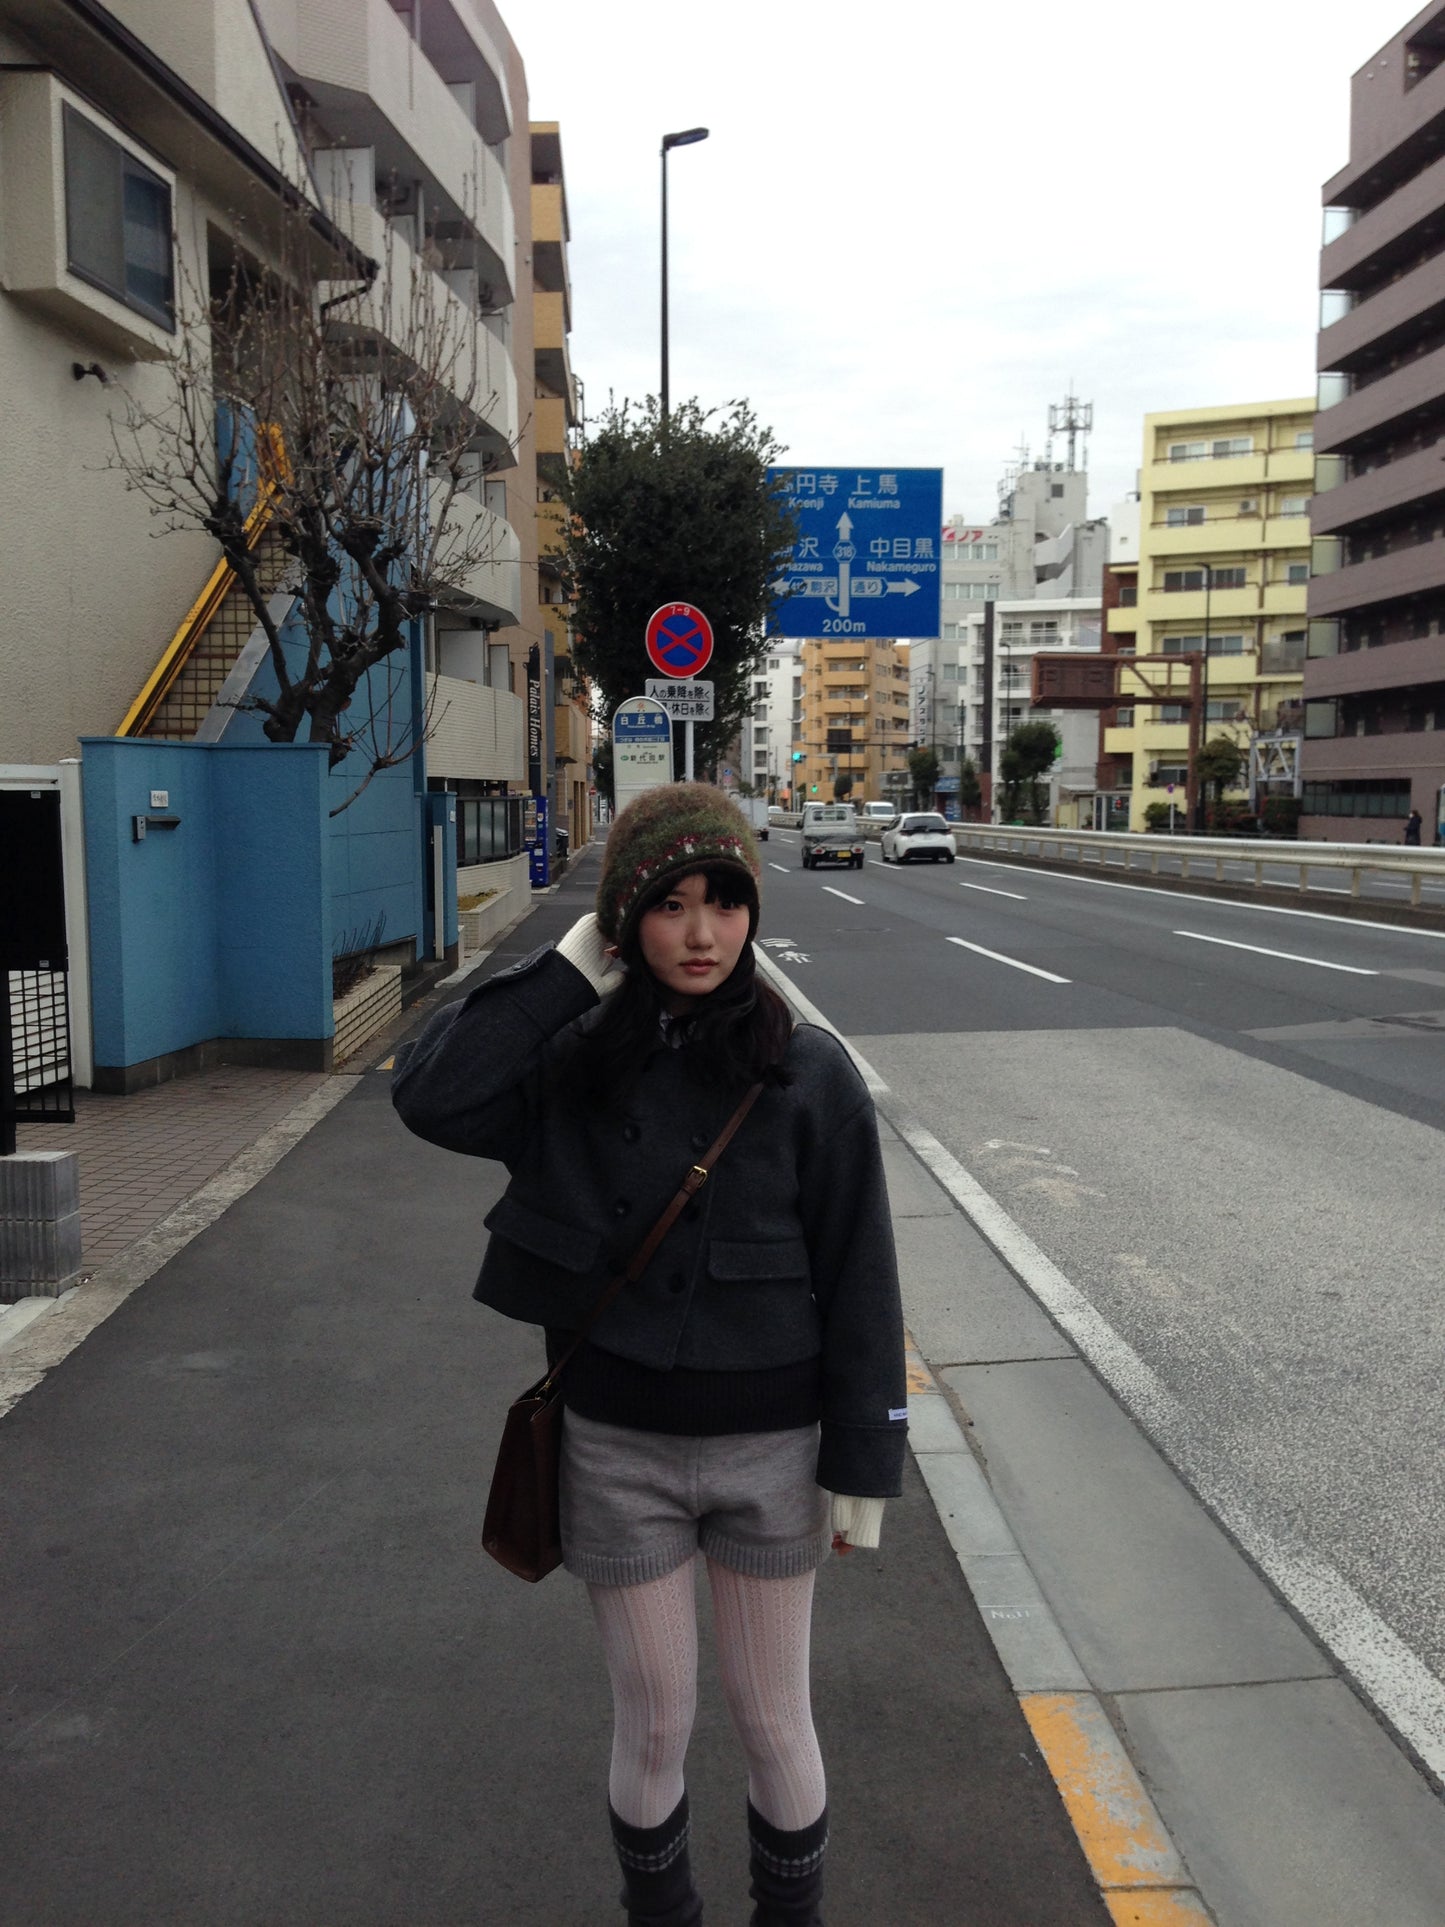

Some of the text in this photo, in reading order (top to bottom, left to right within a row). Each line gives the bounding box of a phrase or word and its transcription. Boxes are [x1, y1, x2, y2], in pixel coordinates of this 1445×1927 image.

[851, 474, 899, 495] 上馬
[848, 497, 901, 509] Kamiuma
[836, 546, 853, 558] 318
[869, 537, 934, 559] 中目黒
[775, 562, 824, 572] omazawa
[866, 561, 937, 574] Nakameguro
[670, 605, 691, 616] 7-9
[822, 619, 867, 633] 200m
[649, 684, 711, 700] 人の乗降を除く
[530, 679, 540, 757] Palais Homes
